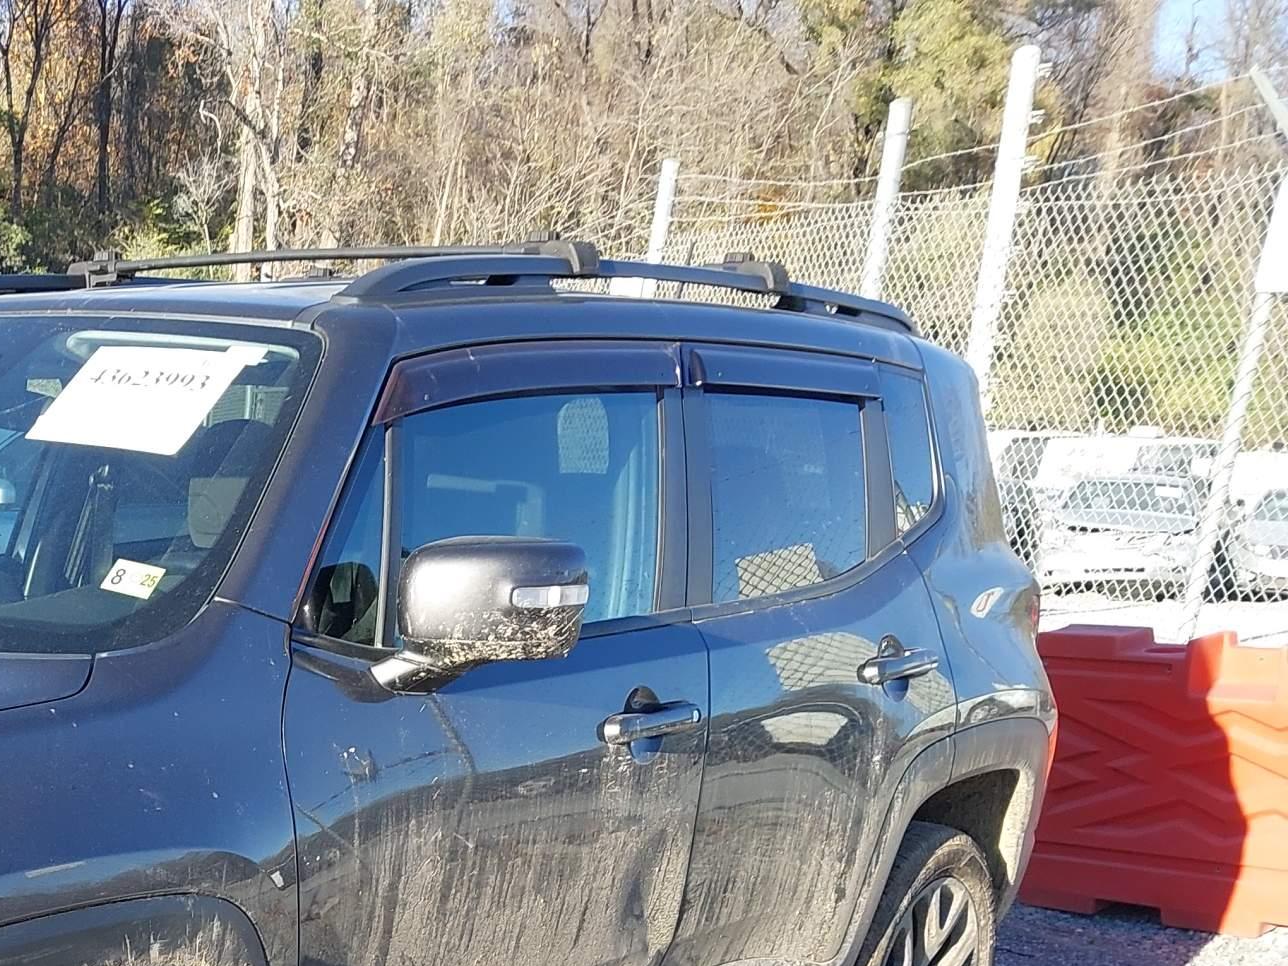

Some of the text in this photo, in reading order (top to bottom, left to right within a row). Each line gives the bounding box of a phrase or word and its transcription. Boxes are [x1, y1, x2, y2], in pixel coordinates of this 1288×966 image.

[90, 368, 211, 390] 43623993
[111, 568, 158, 588] 8 25
